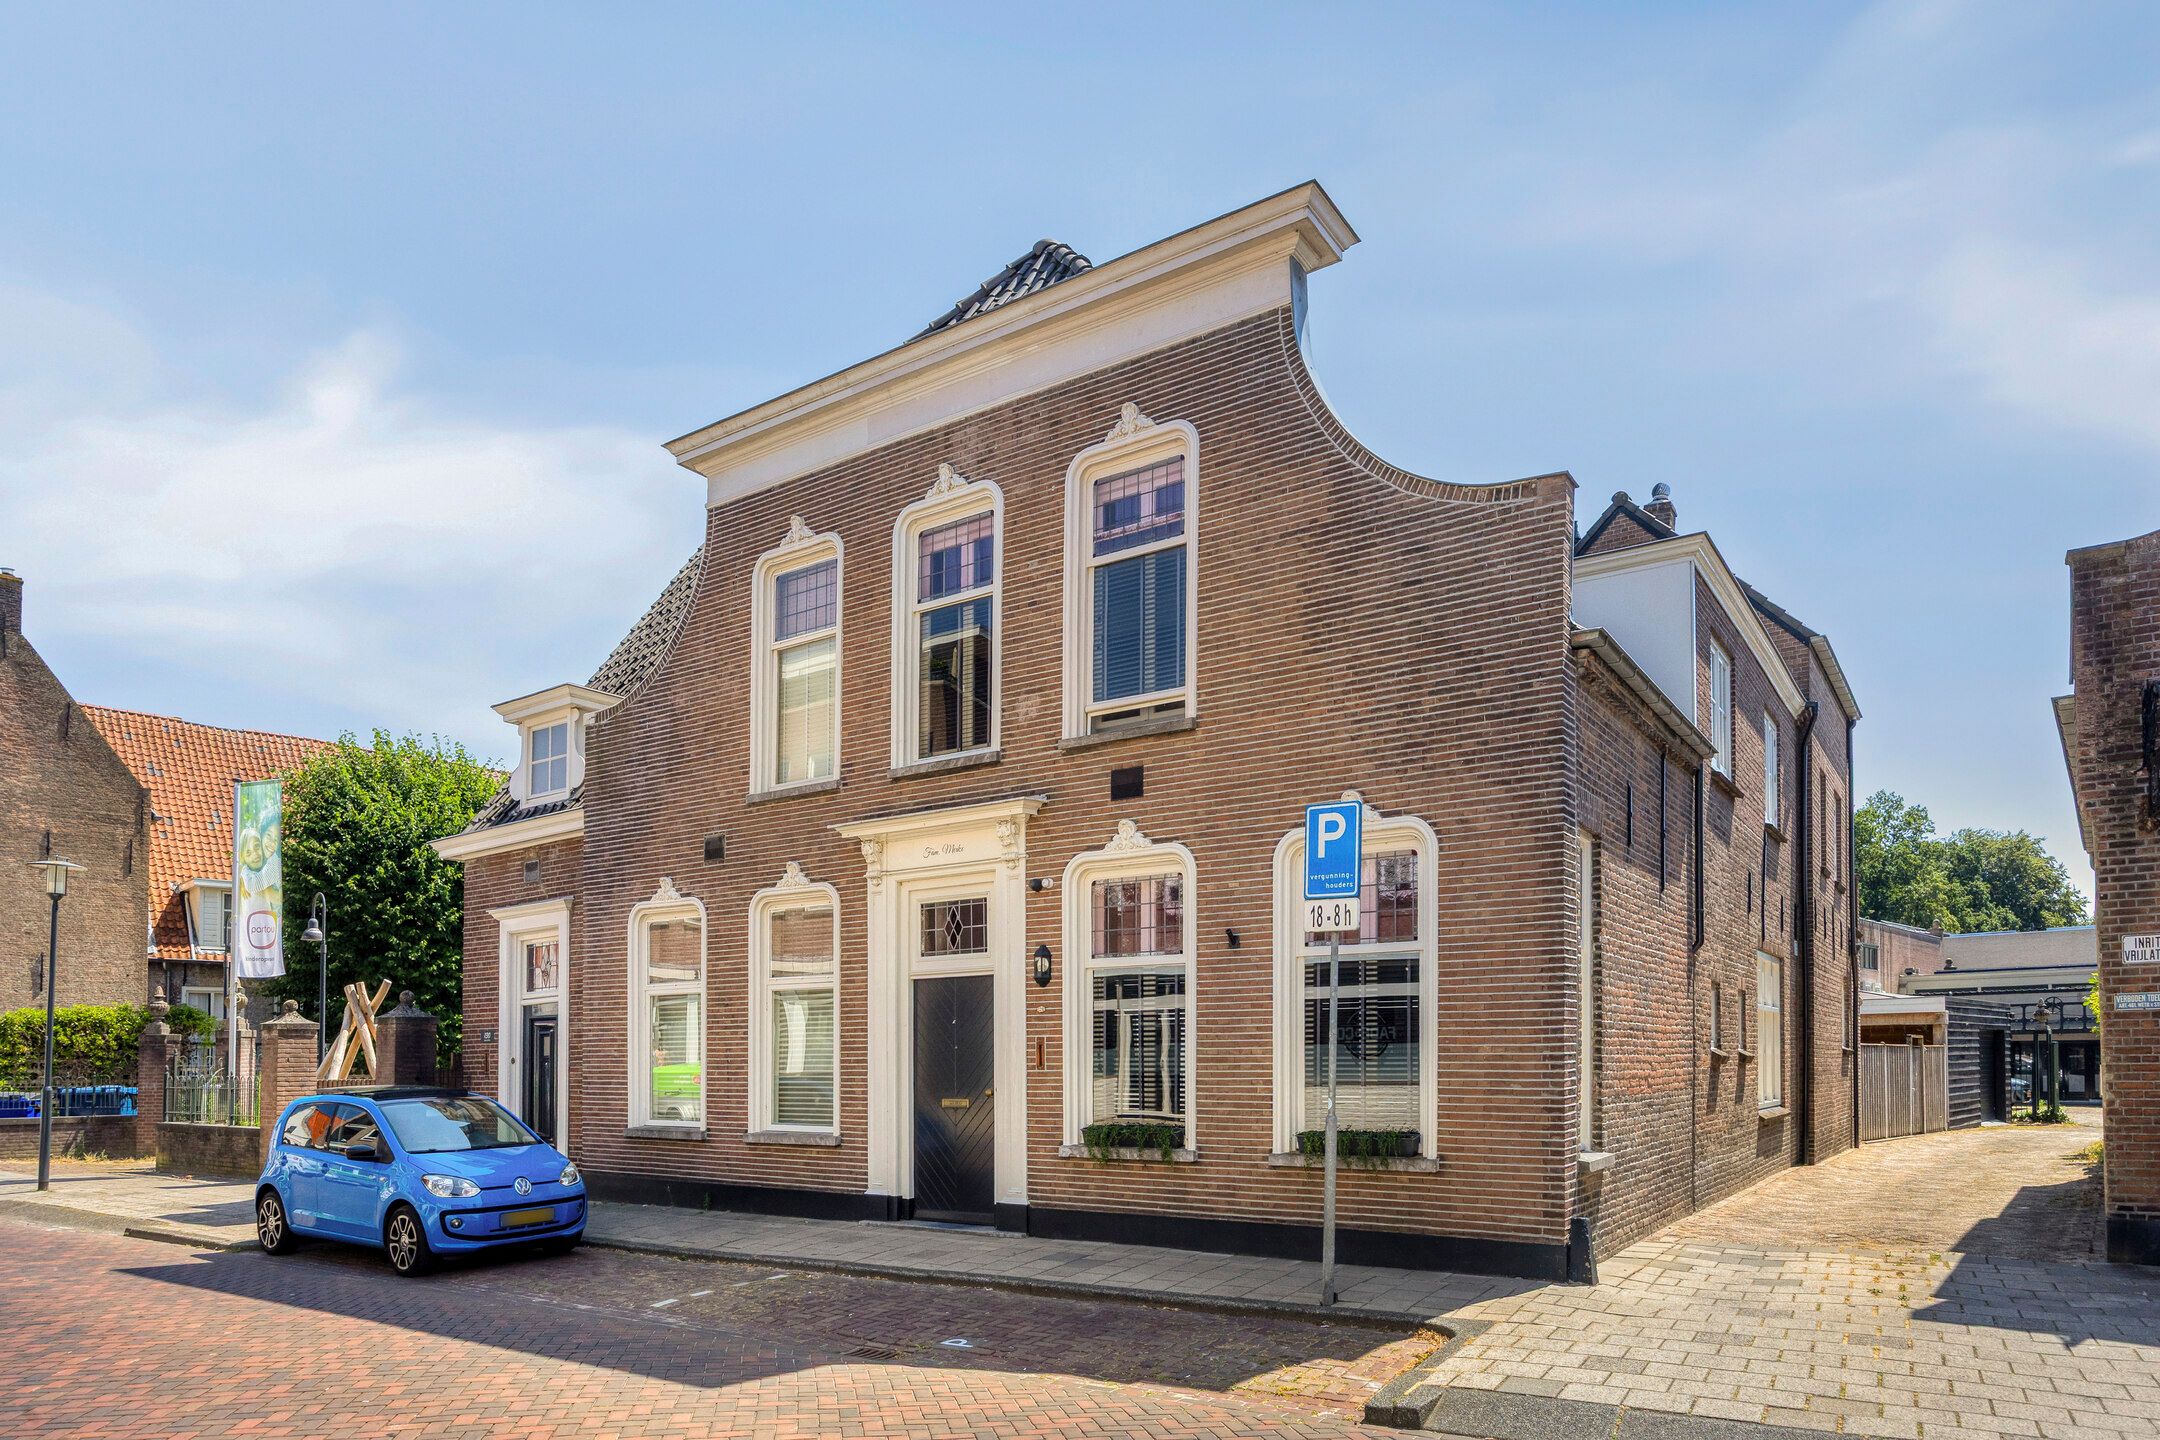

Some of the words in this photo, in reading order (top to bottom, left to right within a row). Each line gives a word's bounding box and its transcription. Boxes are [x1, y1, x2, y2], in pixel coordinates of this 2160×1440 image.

[1318, 812, 1346, 858] P
[1310, 872, 1354, 881] vergunning-
[2134, 936, 2160, 949] INRIT
